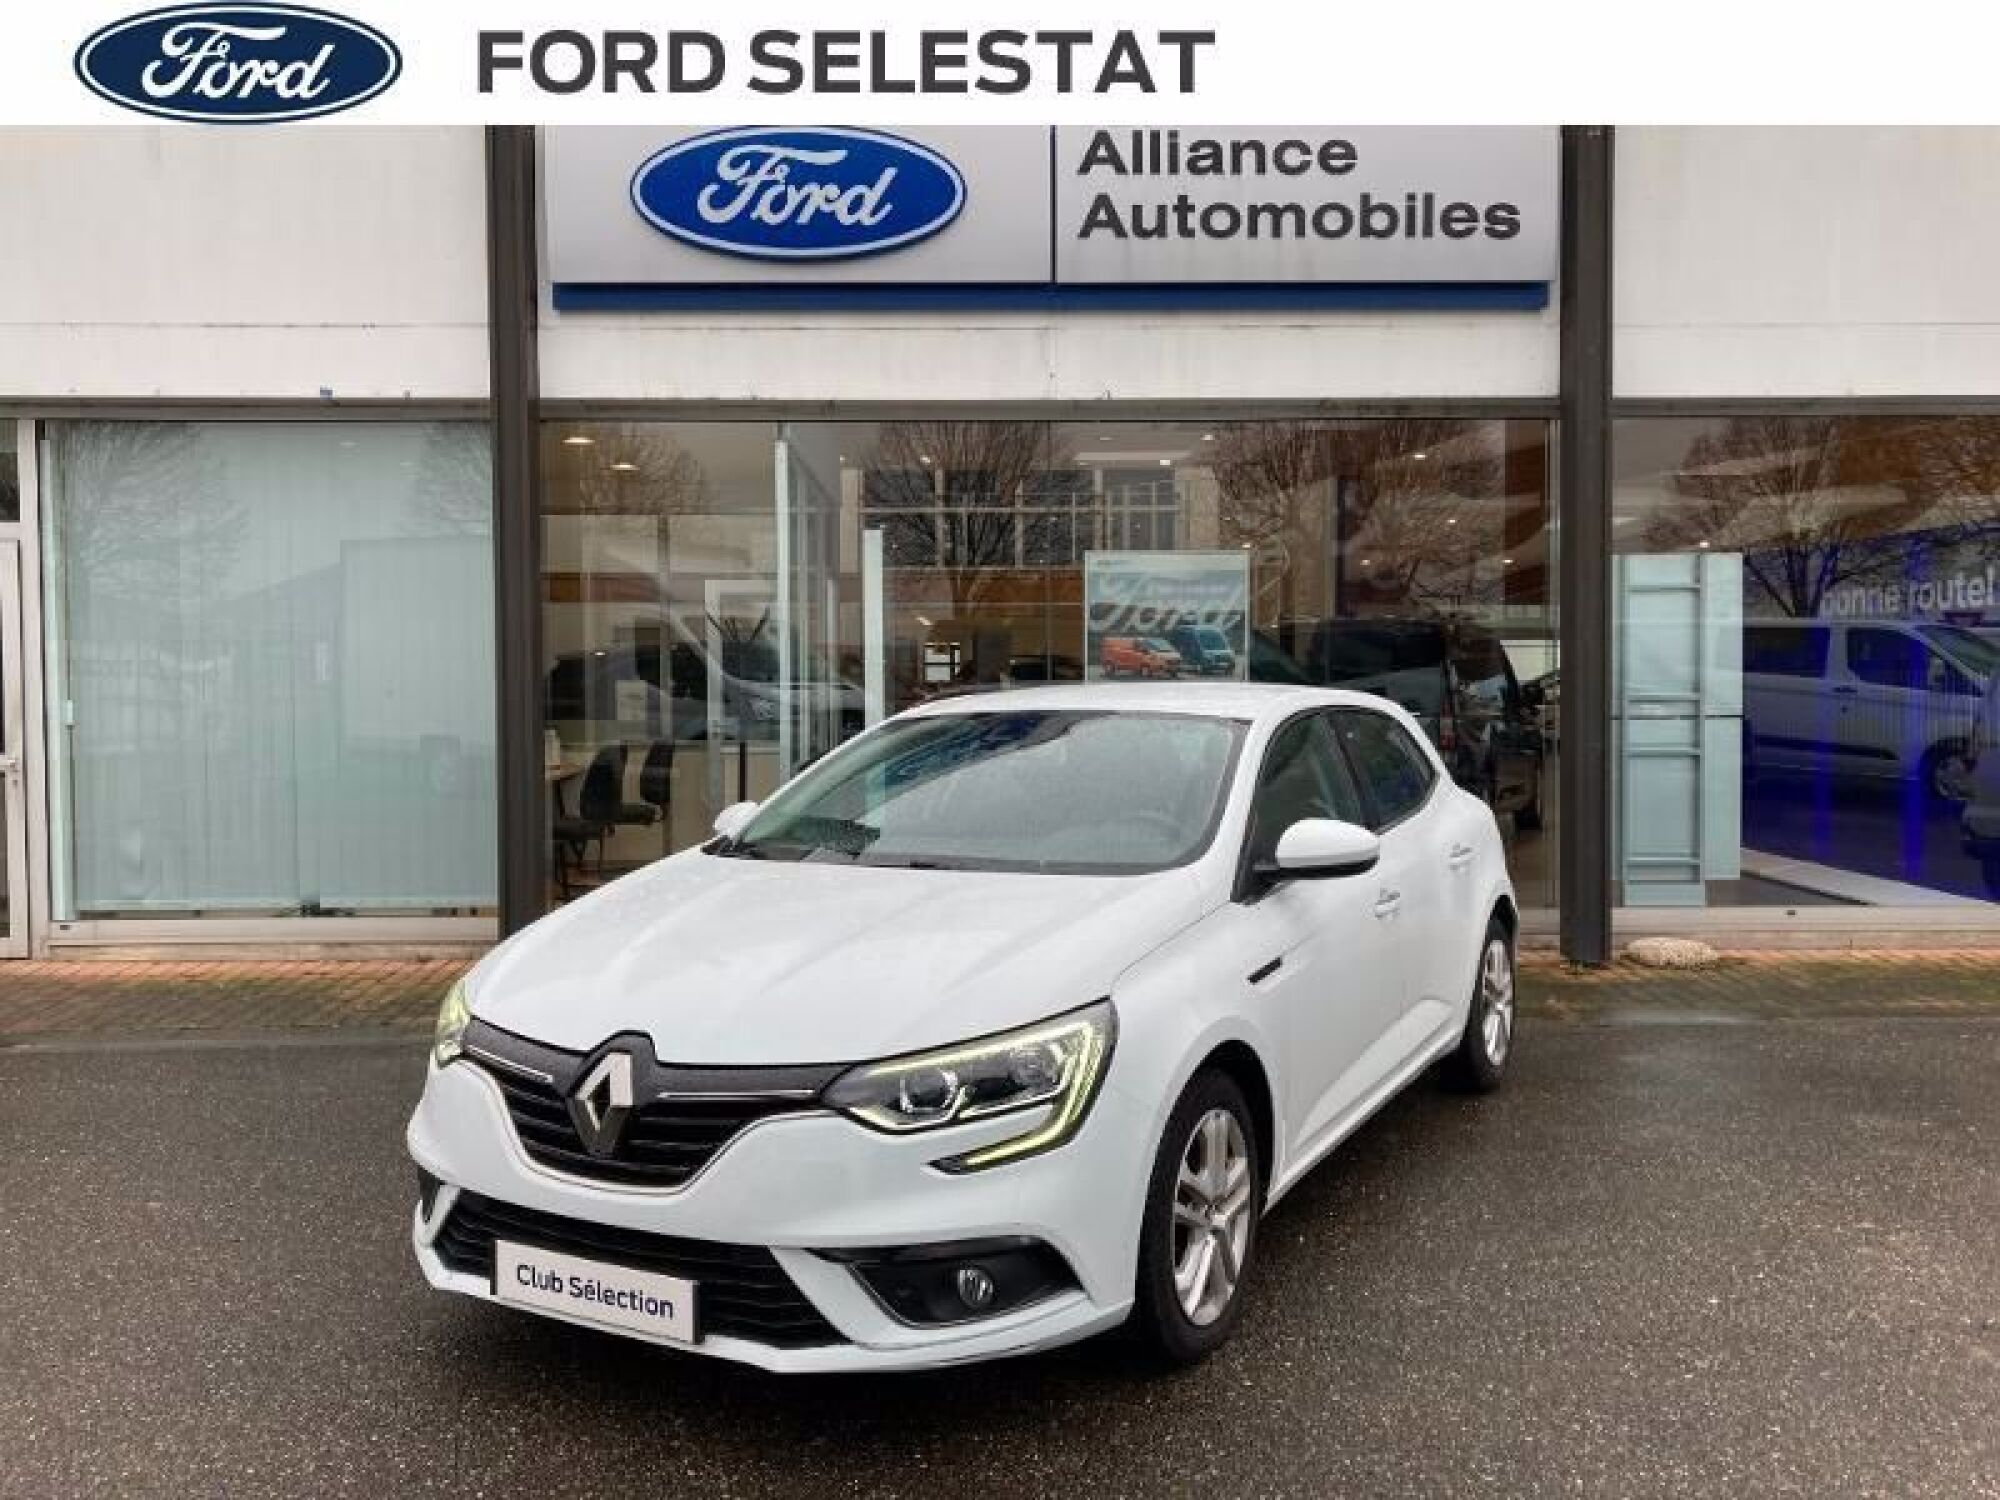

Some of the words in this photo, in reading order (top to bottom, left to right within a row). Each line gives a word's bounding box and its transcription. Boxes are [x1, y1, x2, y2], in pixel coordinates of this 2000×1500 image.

[1078, 130, 1357, 175] Alliance
[696, 144, 895, 226] Ford
[1078, 193, 1520, 240] Automobiles
[517, 1264, 563, 1293] Club
[569, 1277, 674, 1320] Sélection
